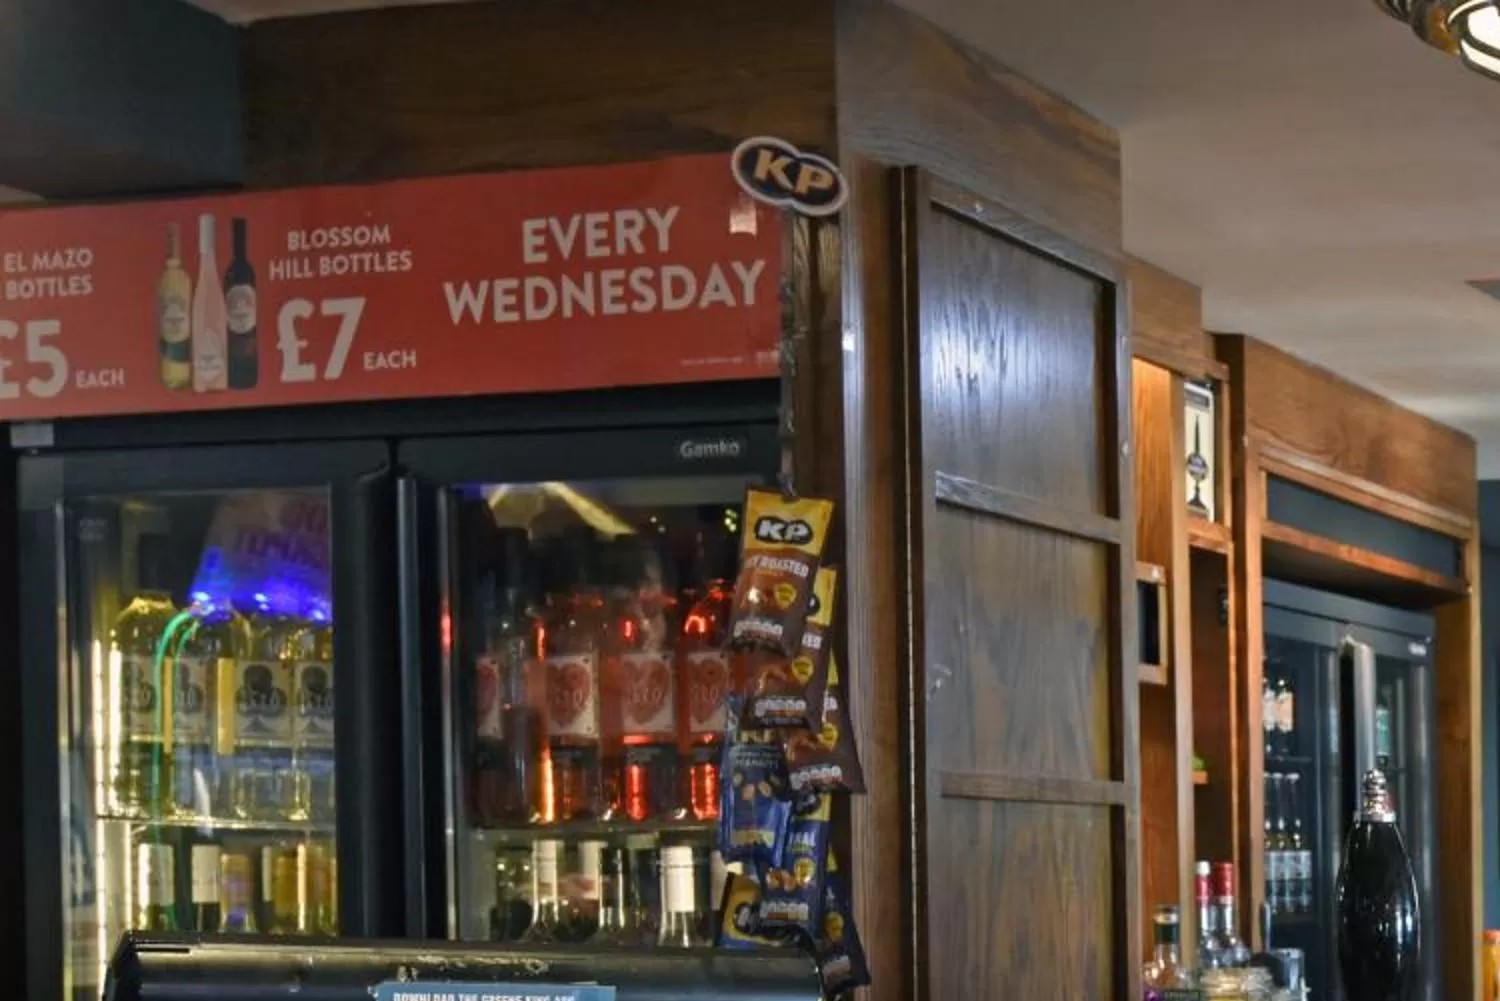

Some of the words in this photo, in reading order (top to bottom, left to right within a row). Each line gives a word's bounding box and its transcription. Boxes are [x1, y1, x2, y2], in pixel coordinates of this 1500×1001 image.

[753, 149, 834, 194] KP
[287, 224, 391, 251] BLOSSOM
[522, 205, 681, 264] EVERY
[4, 253, 27, 273] EL
[32, 248, 94, 272] MAZO
[269, 257, 313, 281] HILL
[319, 250, 413, 277] BOTTLES
[6, 275, 94, 300] BOTTLES
[442, 260, 767, 326] WEDNESDAY
[276, 296, 368, 383] £7
[363, 350, 417, 371] EACH
[76, 368, 125, 389] EACH
[757, 519, 809, 541] KP
